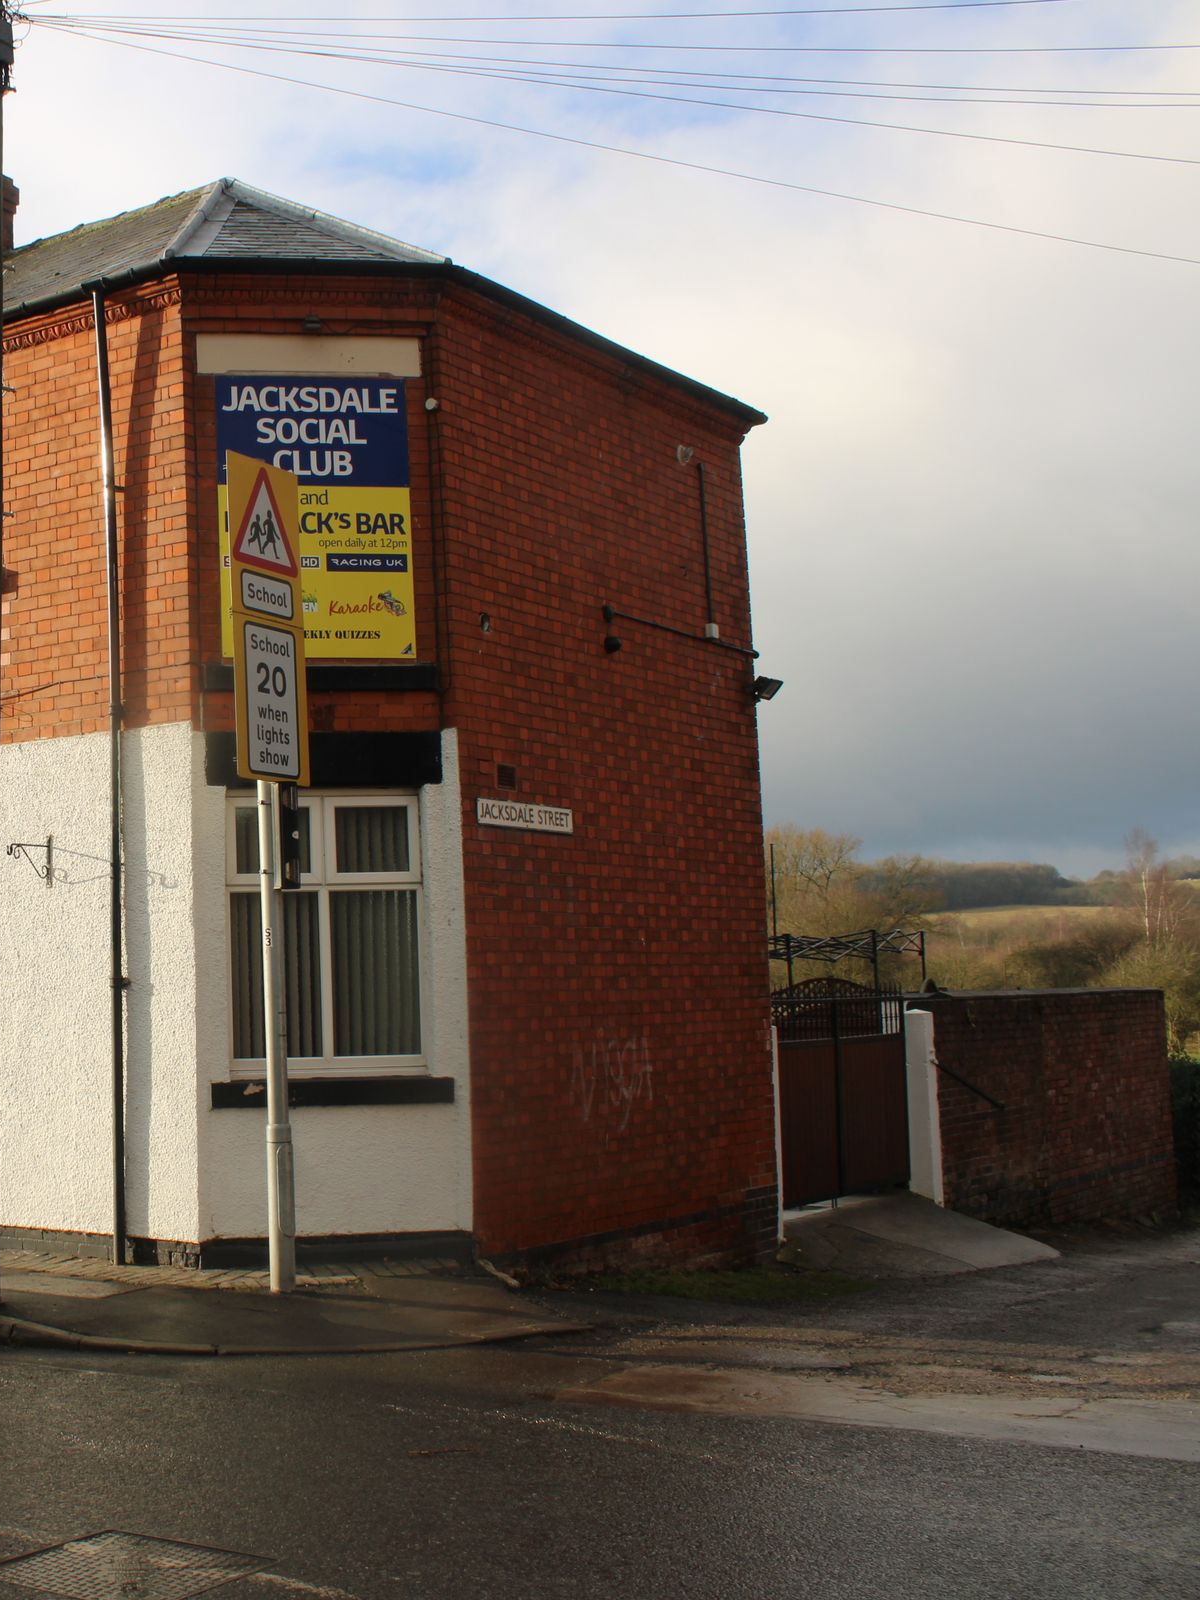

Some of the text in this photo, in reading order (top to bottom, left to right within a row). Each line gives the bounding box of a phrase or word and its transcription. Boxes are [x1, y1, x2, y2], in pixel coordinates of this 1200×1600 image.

[222, 385, 398, 413] JACKSDALE
[256, 418, 367, 445] SOCIAL
[273, 450, 352, 476] CLUB
[300, 489, 328, 505] and
[299, 512, 406, 535] CK'S BAR
[319, 538, 407, 550] open daily at 12pm
[302, 558, 318, 567] HD
[331, 558, 403, 567] RACING UK
[247, 582, 288, 609] School
[329, 595, 383, 616] Karaoke
[250, 633, 290, 658] School
[304, 630, 381, 640] EKLY QUIZZES
[256, 662, 287, 698] 20
[258, 704, 288, 724] when
[257, 724, 290, 746] lights
[259, 748, 289, 768] show
[480, 803, 570, 827] JACKSDALE STREET
